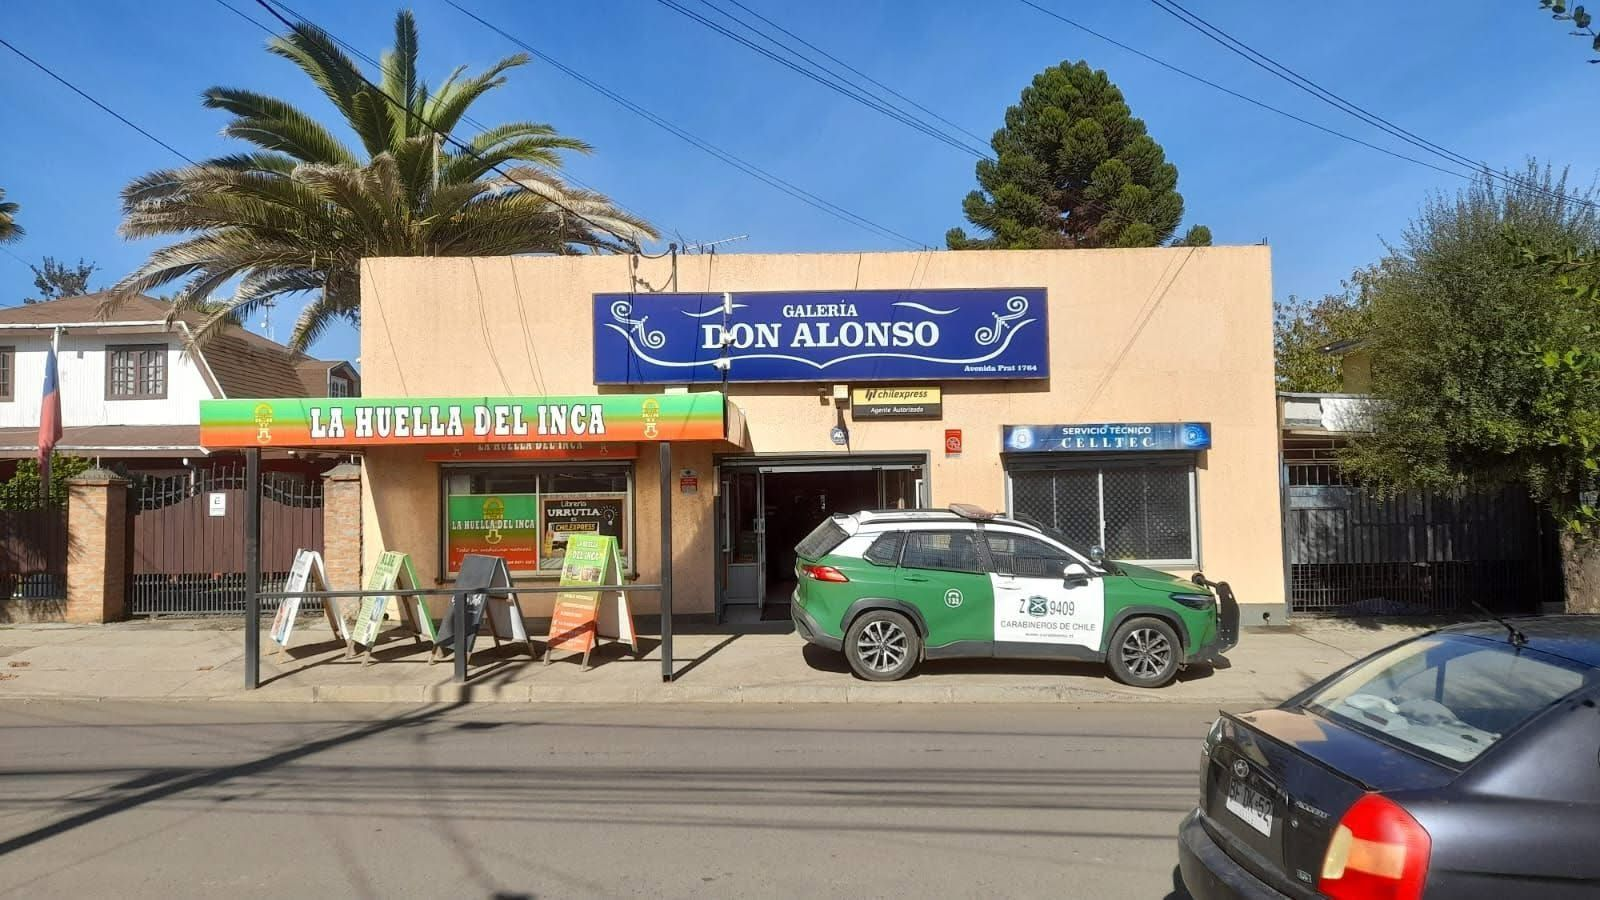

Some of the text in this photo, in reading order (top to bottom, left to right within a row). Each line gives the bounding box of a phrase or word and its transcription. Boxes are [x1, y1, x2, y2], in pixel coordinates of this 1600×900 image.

[782, 299, 858, 318] GALERÍA
[702, 321, 940, 349] DON ALONSO
[877, 388, 928, 400] chilexpress
[871, 407, 891, 415] Agente
[310, 404, 606, 438] LA HUELLA DEL INCA
[1062, 427, 1108, 435] SERVICIO
[1061, 437, 1153, 448] CELLTEC
[547, 508, 601, 517] URRUTIA
[452, 519, 535, 530] LA HUELLA DEL INCA
[1019, 598, 1075, 616] Z 9409
[1000, 620, 1097, 632] CARABINEROS DE CHILE
